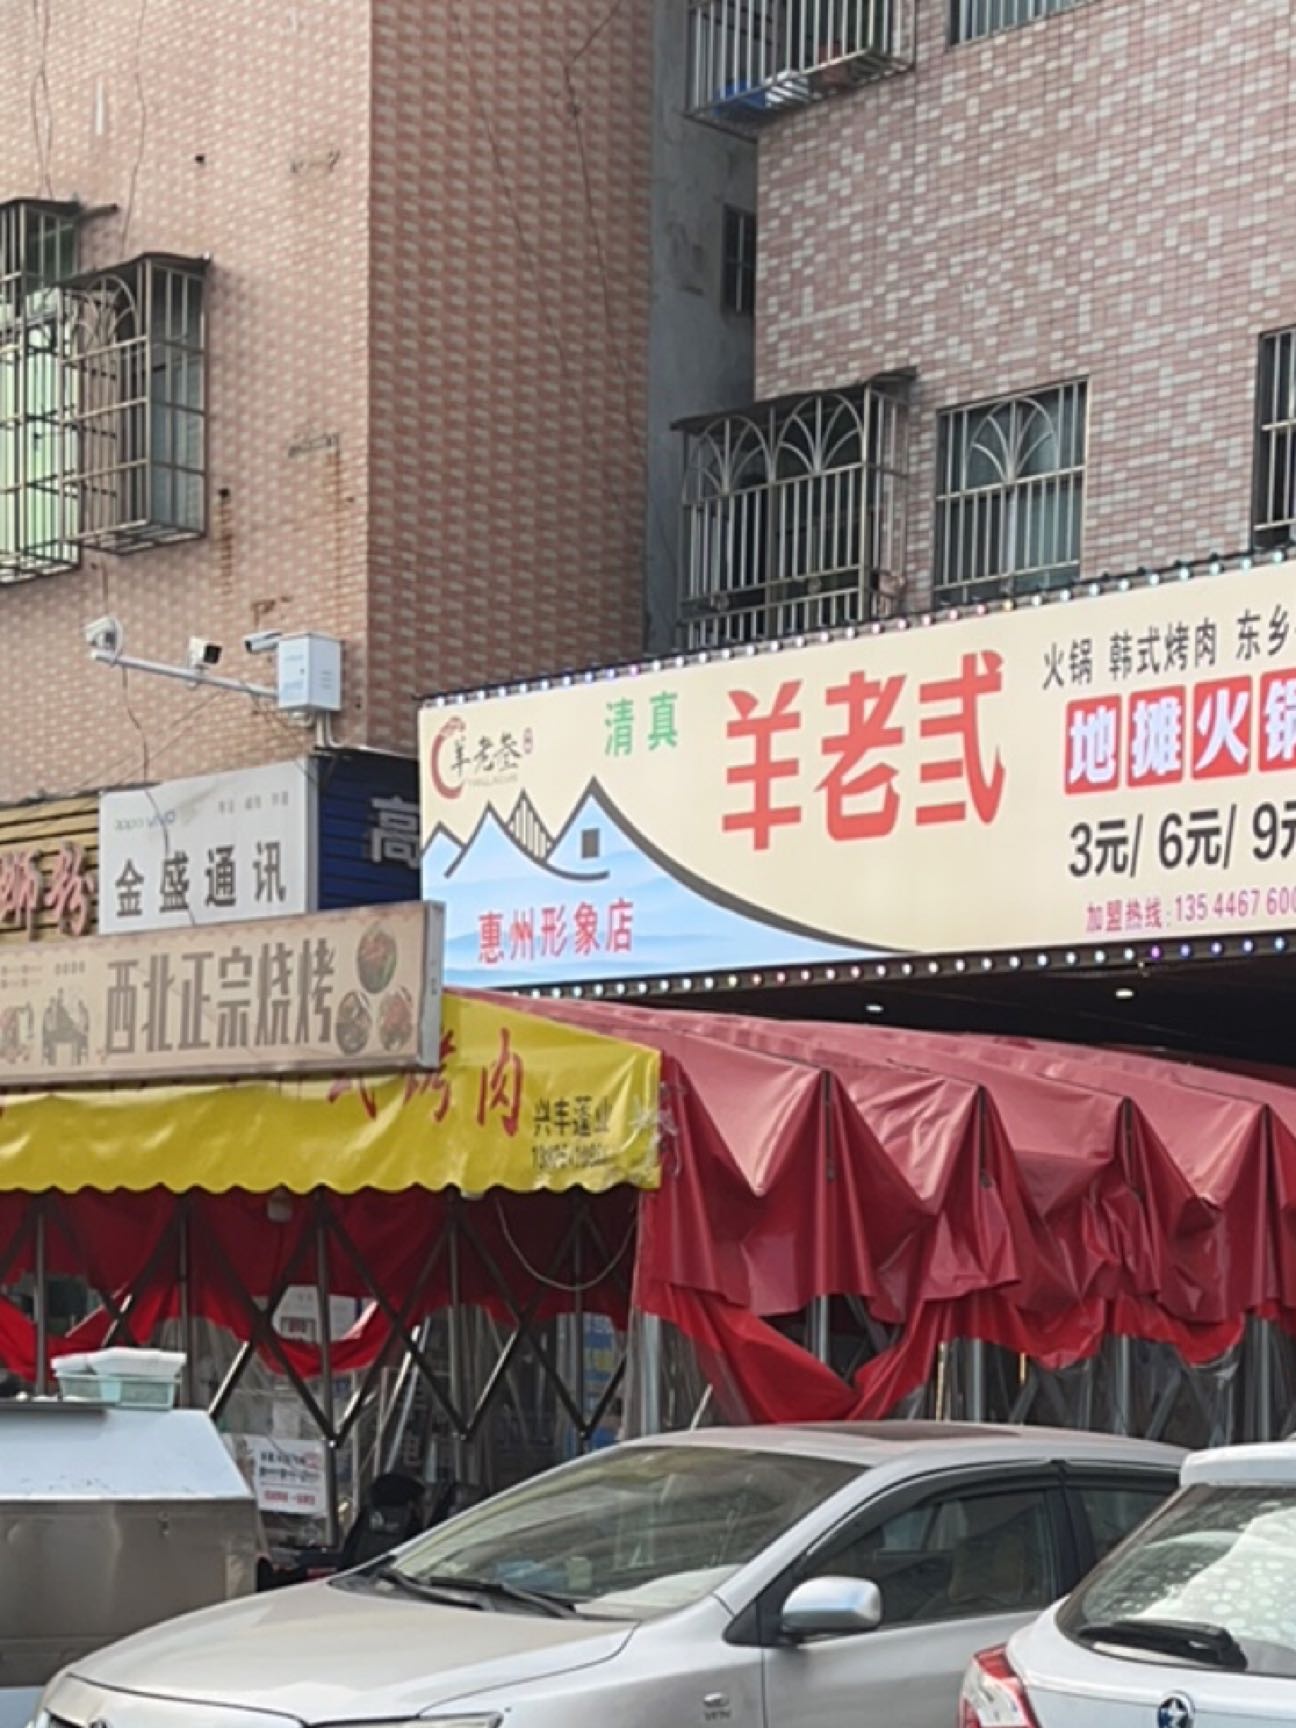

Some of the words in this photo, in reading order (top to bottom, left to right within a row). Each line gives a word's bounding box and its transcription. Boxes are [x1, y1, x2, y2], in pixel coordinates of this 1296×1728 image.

[1042, 638, 1094, 691] 火锅
[1108, 617, 1218, 681] 韩式烤肉
[604, 691, 680, 757] 清真
[1068, 813, 1145, 878] 3元/
[1157, 802, 1238, 870] 6元/
[115, 840, 287, 917] 金盛通讯
[1213, 890, 1261, 917] 4467
[477, 898, 634, 964] 惠州形象店
[104, 938, 336, 1055] 西北正宗烧烤
